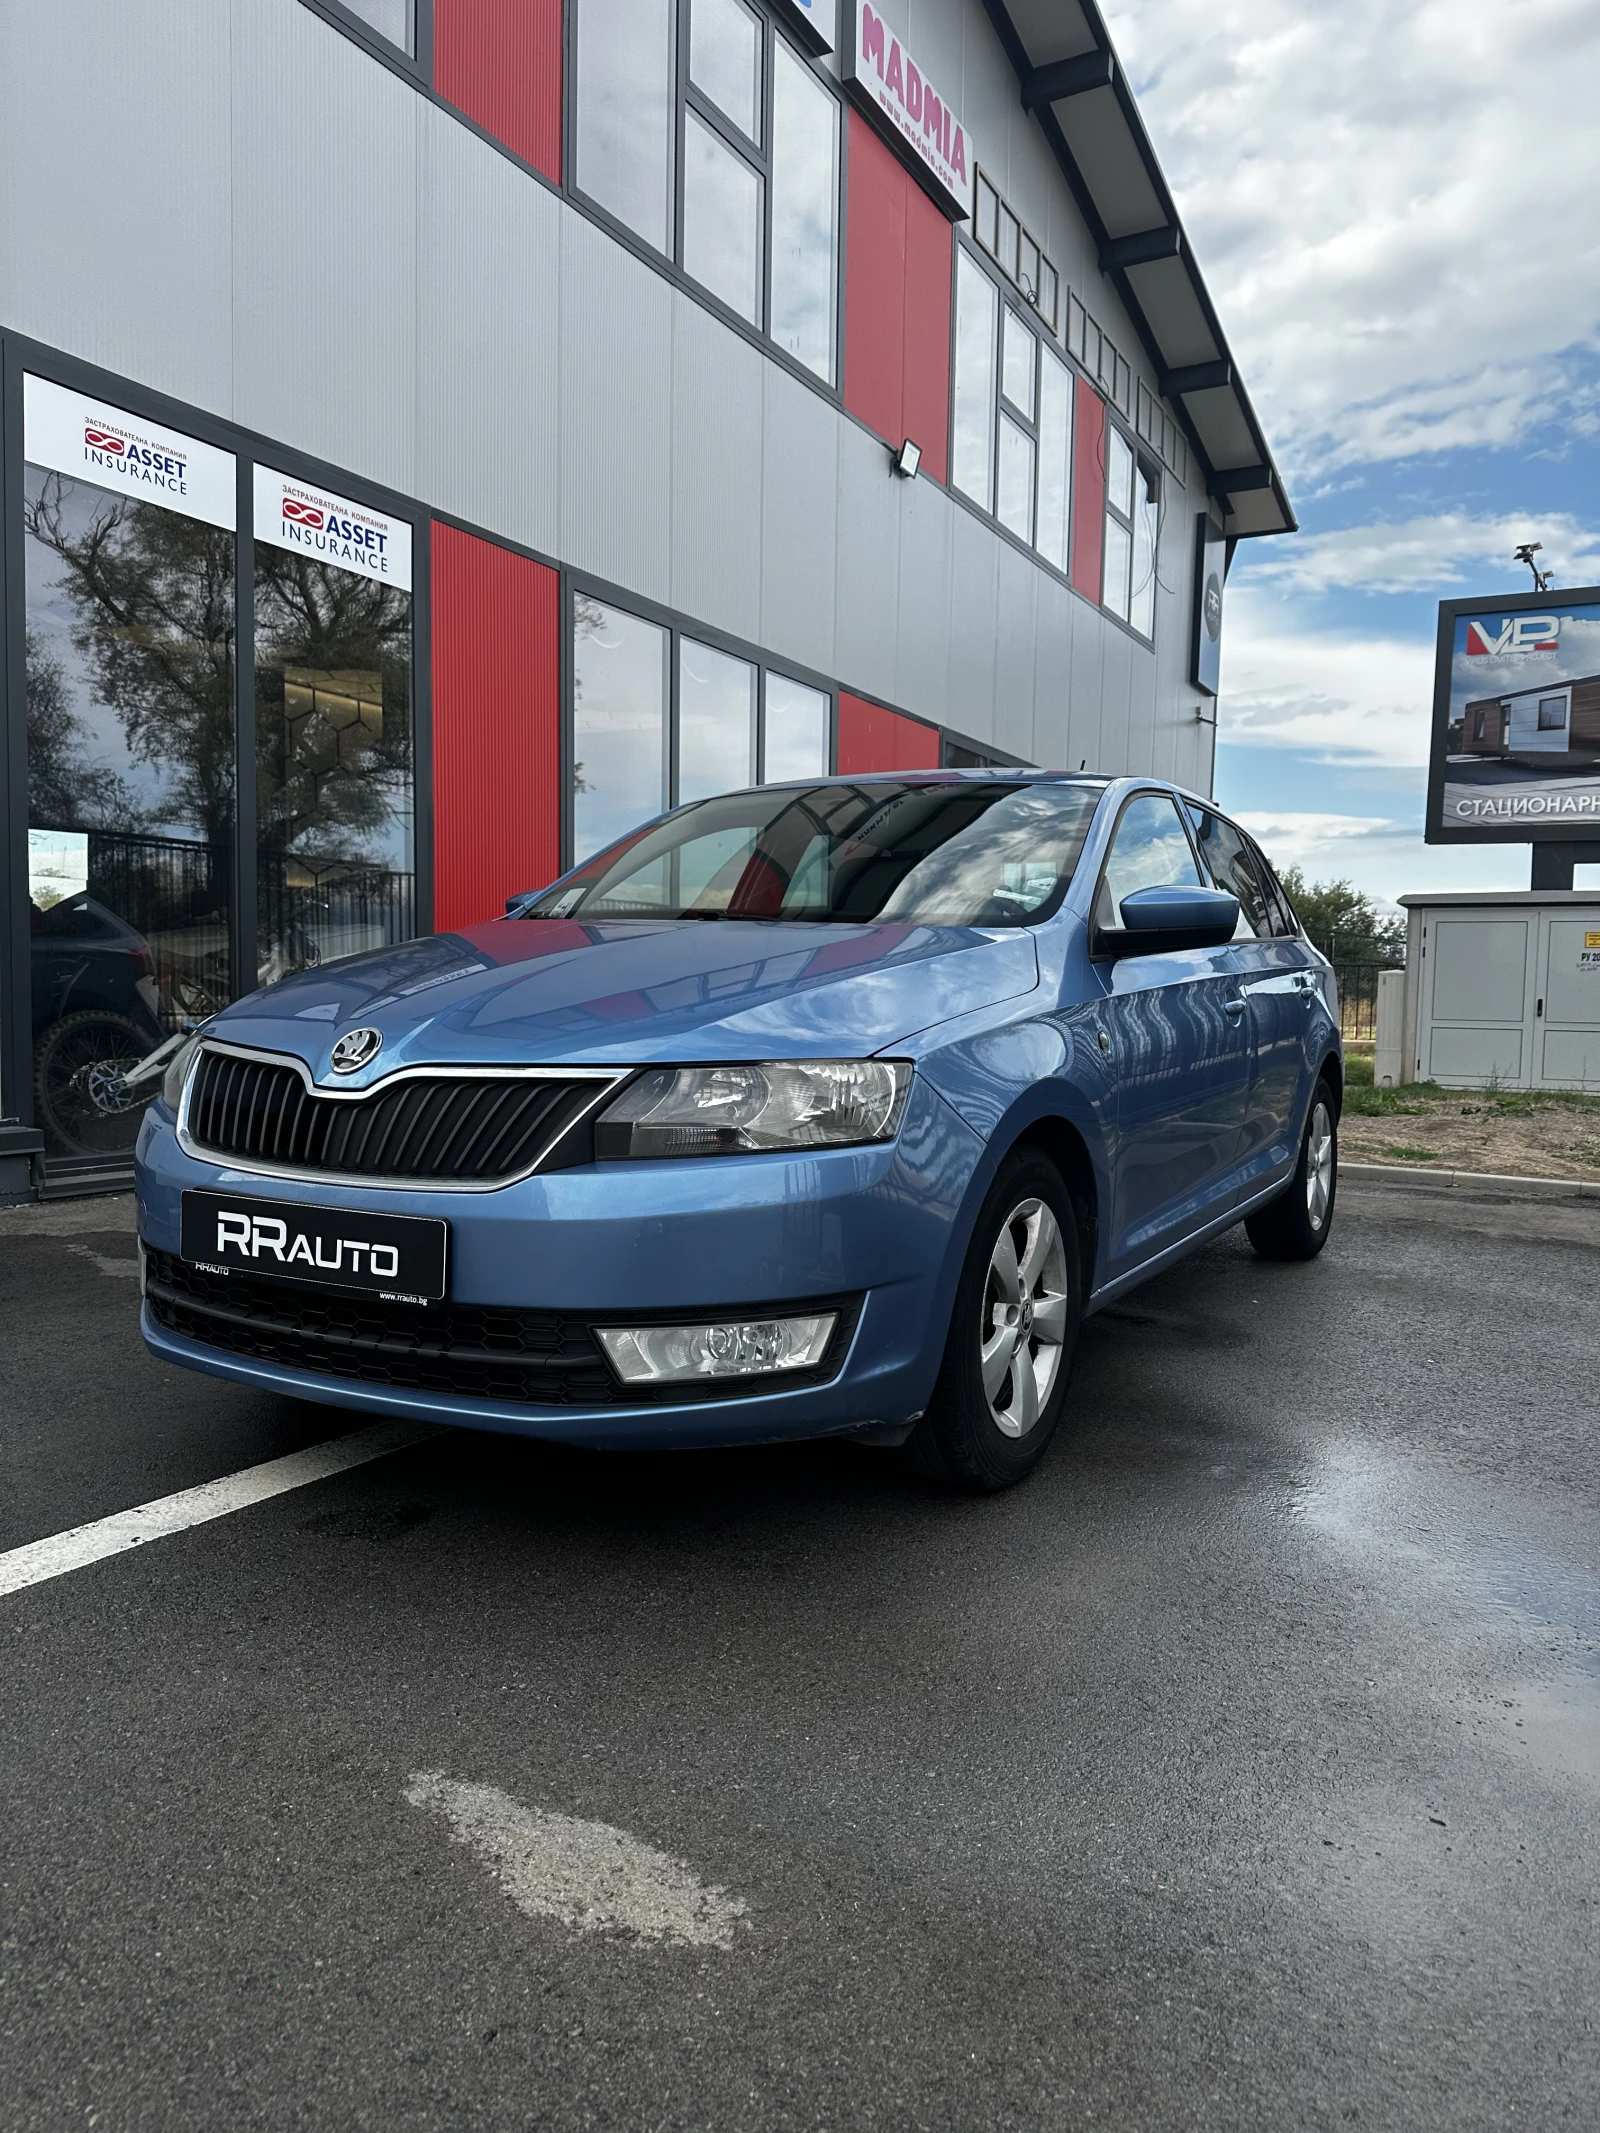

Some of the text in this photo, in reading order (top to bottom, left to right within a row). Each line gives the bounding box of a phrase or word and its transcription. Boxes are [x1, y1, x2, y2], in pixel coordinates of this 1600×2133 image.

[863, 3, 967, 187] MADMIA
[879, 90, 954, 190] www.madmia.com
[84, 416, 187, 460] ЗАСТРАХОВАТЕЛНА КОМПАНИЯ
[126, 444, 187, 478] ASSET
[84, 447, 187, 495] INSURANCE
[282, 484, 389, 532] ЗАСТРАХОВАТЕЛНА КОМПАНИЯ
[282, 521, 389, 573] INSURANCE
[326, 515, 388, 553] ASSET
[1456, 796, 1600, 817] СТАЦИОНАРН
[379, 1292, 428, 1306] www.rrauto.bg
